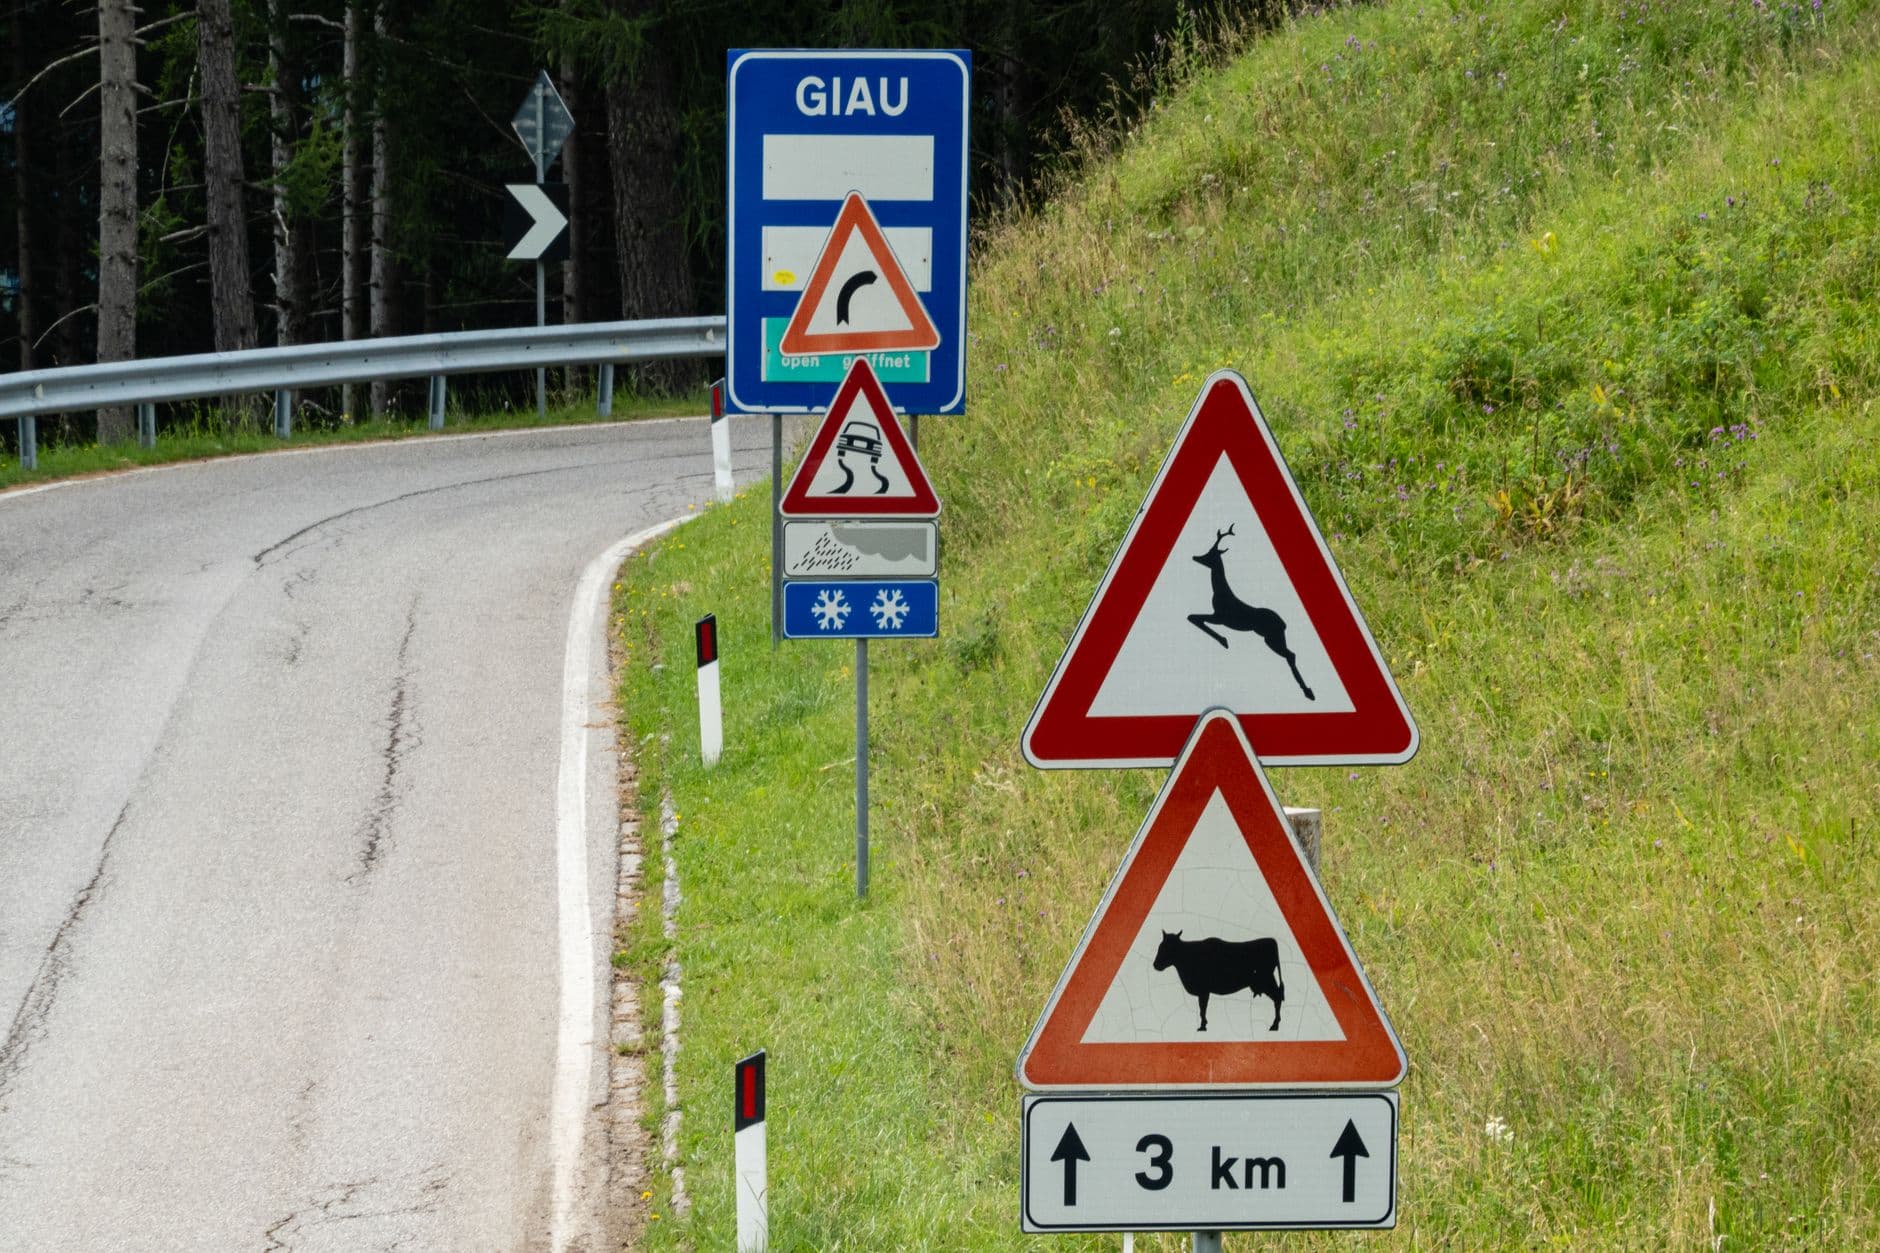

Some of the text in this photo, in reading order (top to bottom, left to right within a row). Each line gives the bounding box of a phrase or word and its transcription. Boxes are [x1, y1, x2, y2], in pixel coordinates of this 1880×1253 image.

[795, 76, 909, 117] GIAU
[781, 353, 911, 370] open gffnet
[1134, 1133, 1286, 1191] 3 km
